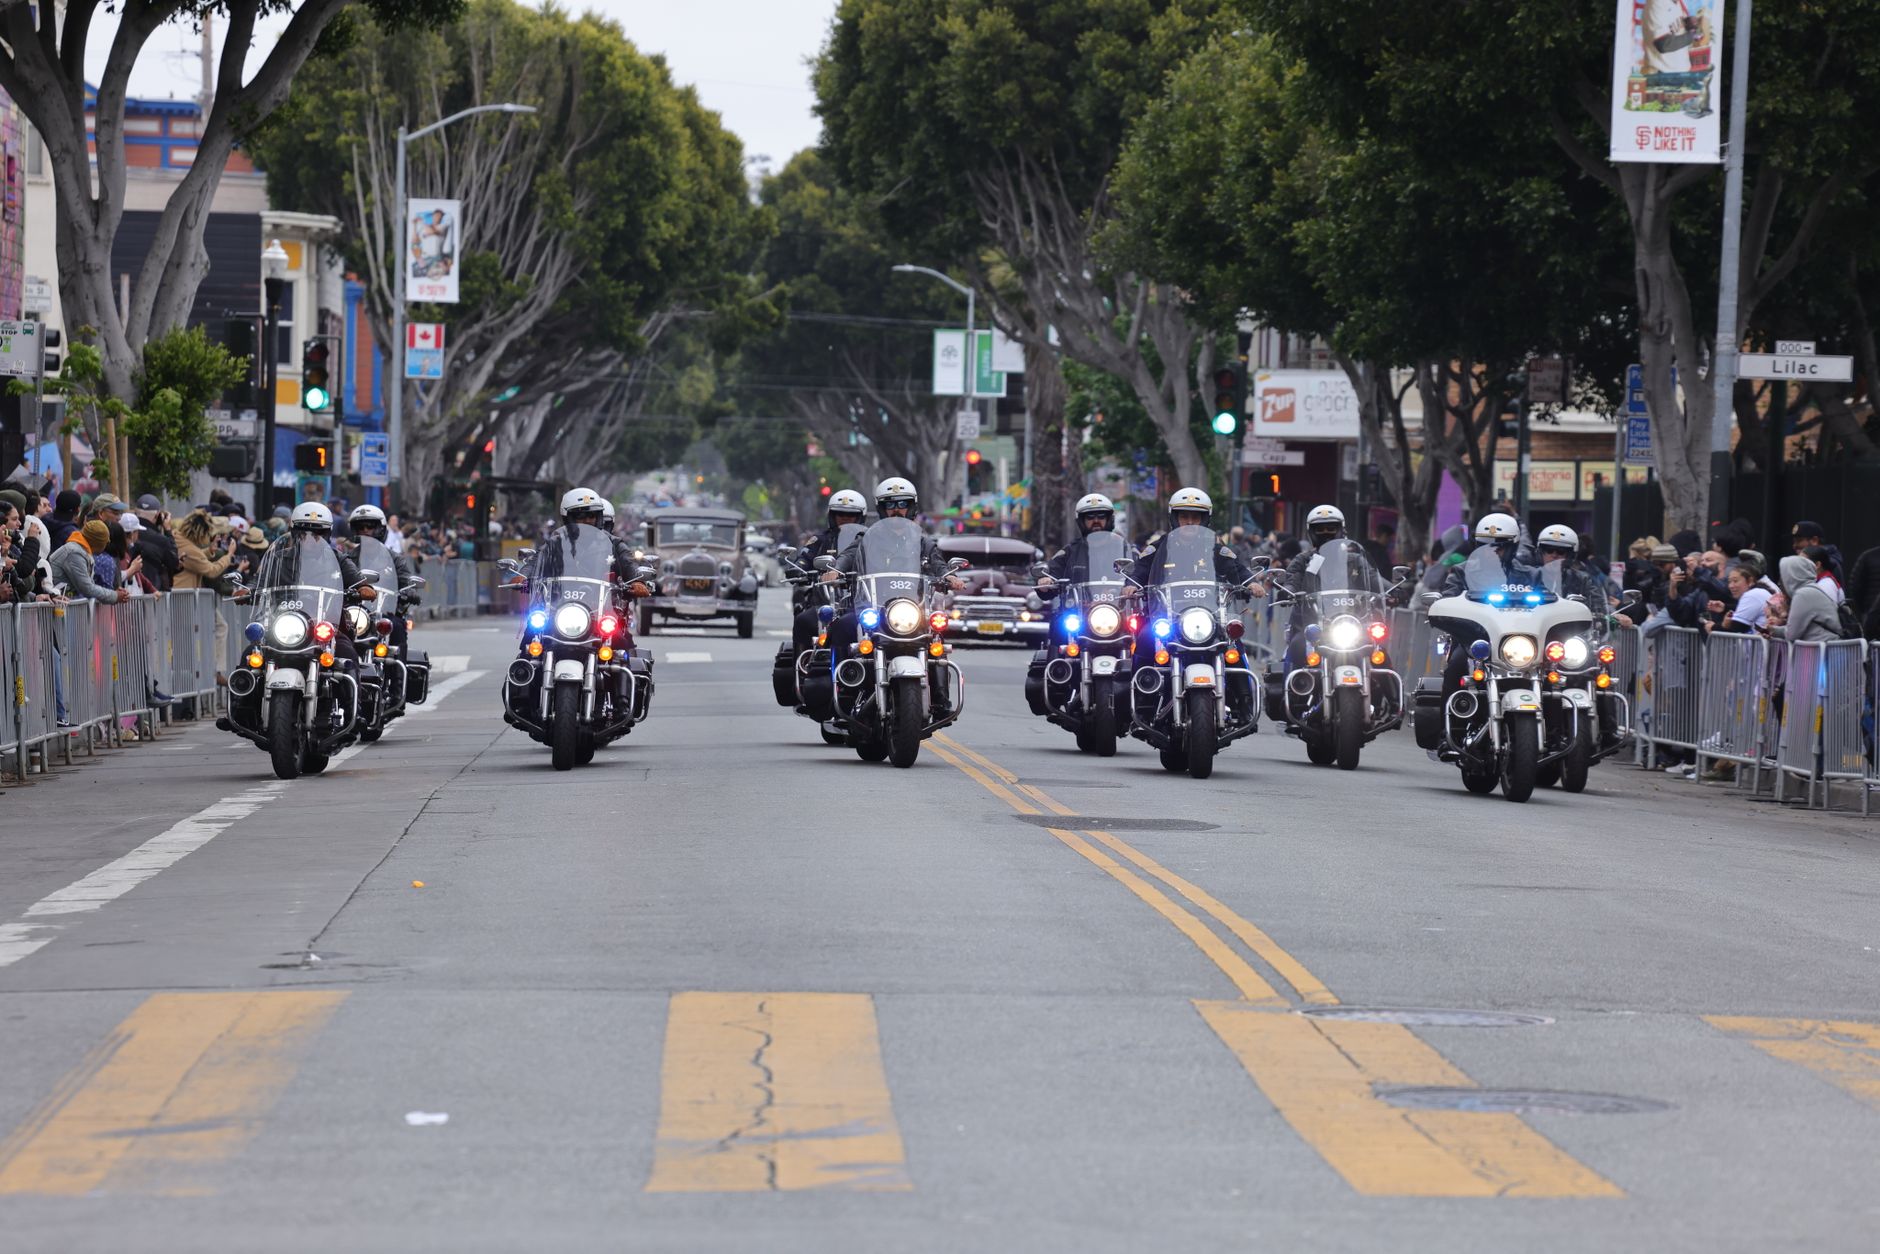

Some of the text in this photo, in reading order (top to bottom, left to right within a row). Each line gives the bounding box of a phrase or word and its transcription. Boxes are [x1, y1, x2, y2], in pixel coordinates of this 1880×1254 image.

[1654, 126, 1696, 138] NOTHING
[1654, 136, 1696, 151] LIKE IT
[1780, 343, 1802, 353] 000
[1772, 360, 1819, 374] Lilac
[960, 424, 977, 436] 20
[1631, 420, 1647, 430] Pay
[1262, 453, 1287, 464] Capp
[890, 580, 912, 590] 382
[563, 590, 587, 600] 387
[1093, 593, 1115, 602] 383
[1183, 589, 1207, 598] 358
[280, 600, 304, 610] 369
[1332, 597, 1355, 607] 363
